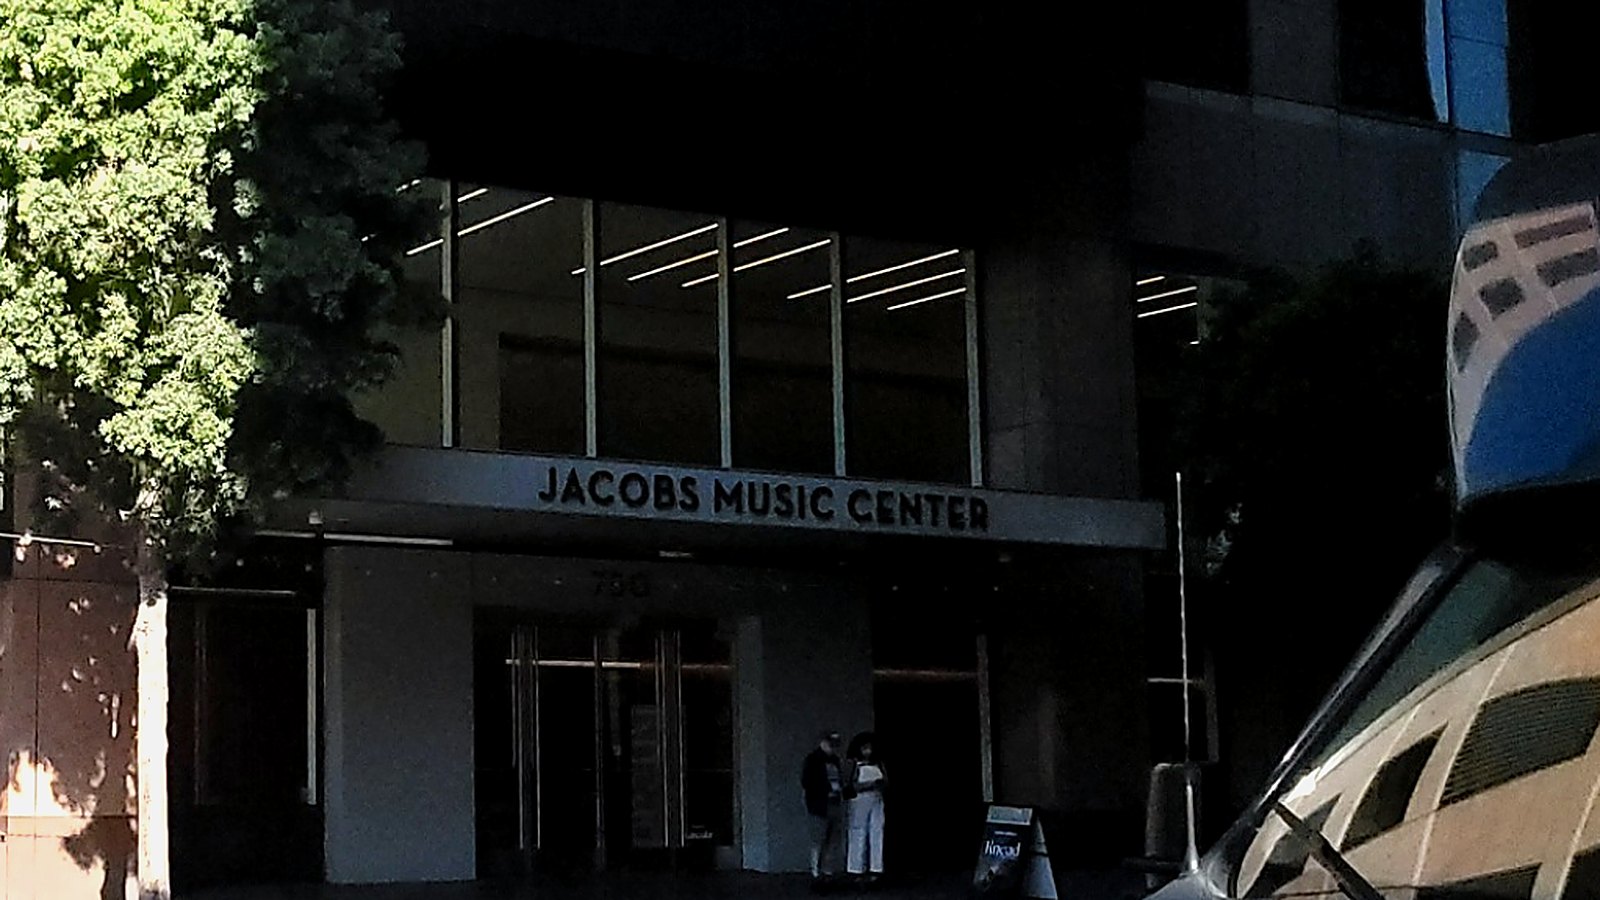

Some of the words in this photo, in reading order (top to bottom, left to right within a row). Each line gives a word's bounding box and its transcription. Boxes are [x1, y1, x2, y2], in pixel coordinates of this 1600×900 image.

[539, 467, 699, 512] JACOBS
[714, 479, 834, 520] MUSIC
[848, 489, 988, 530] CENTER
